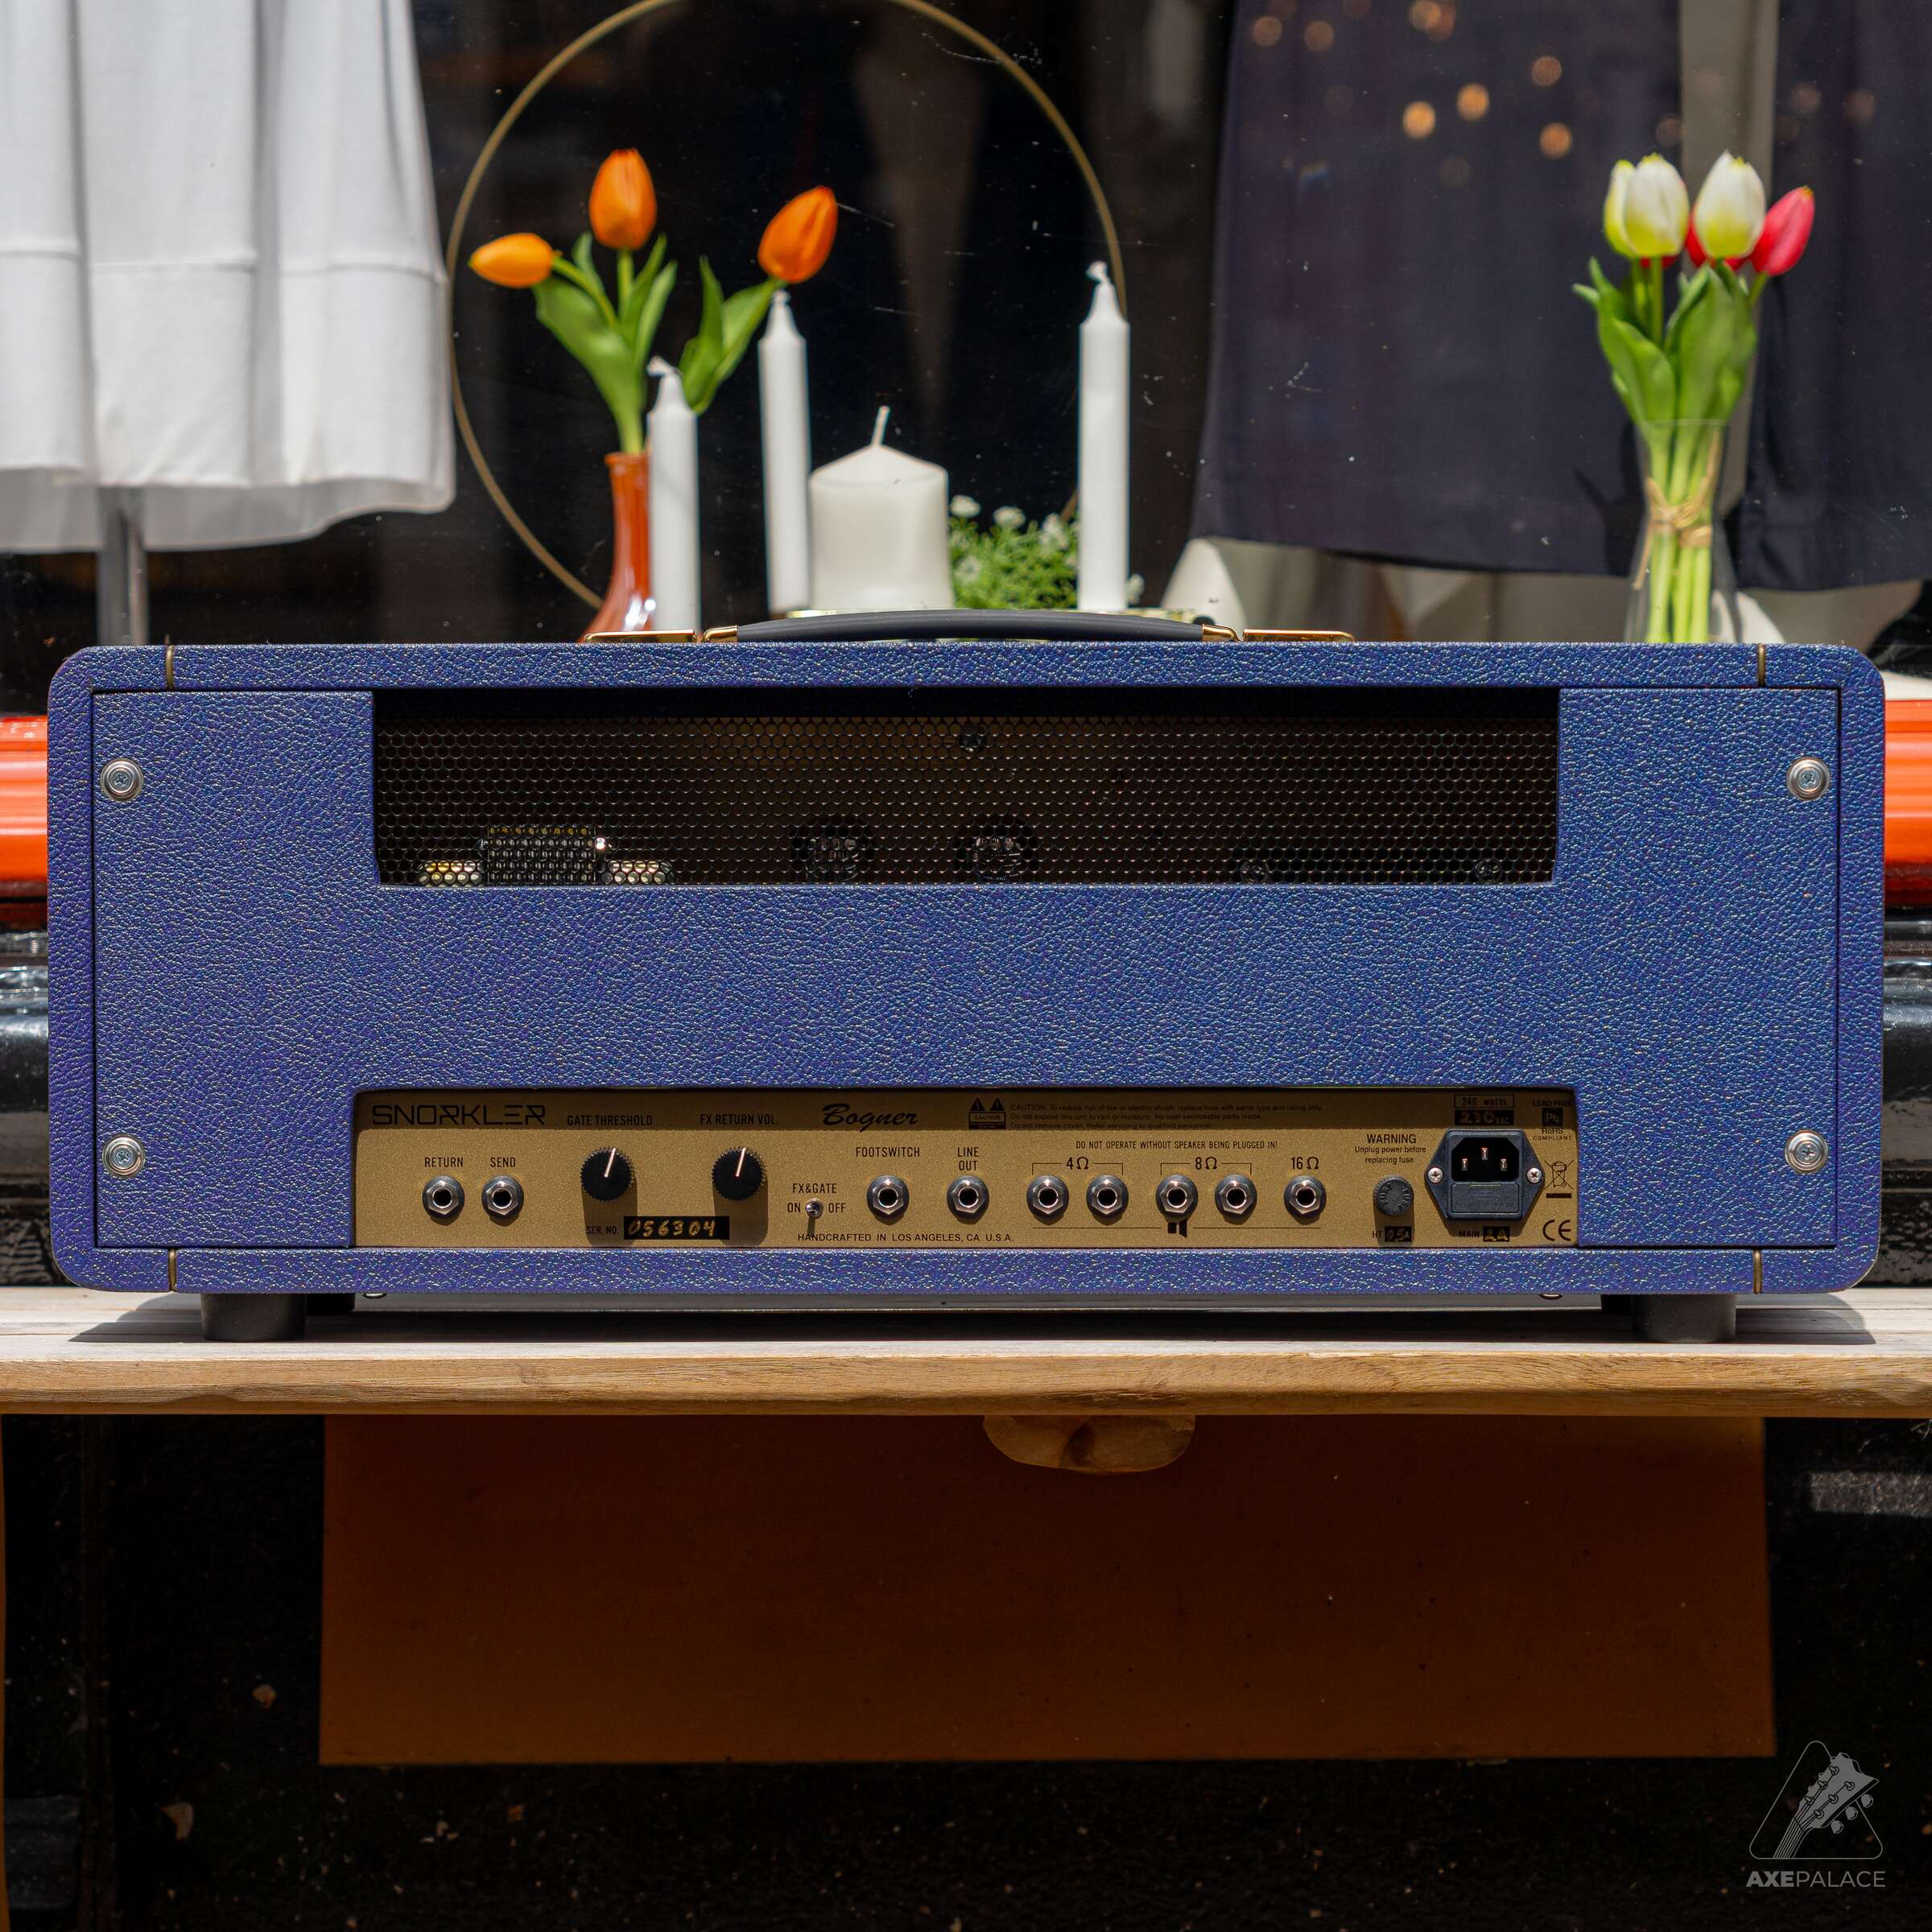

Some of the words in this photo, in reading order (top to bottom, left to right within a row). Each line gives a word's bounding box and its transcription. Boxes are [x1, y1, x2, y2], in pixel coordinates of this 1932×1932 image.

[1484, 1097, 1508, 1106] watts
[1533, 1100, 1552, 1108] LEAD
[372, 1104, 546, 1125] SNORKLER
[567, 1114, 592, 1126] GATE
[594, 1114, 653, 1126] THRESHOLD
[700, 1113, 712, 1125] FX
[715, 1113, 754, 1125] RETURN
[758, 1113, 779, 1125] VOL.
[822, 1103, 919, 1133] Bogner
[1366, 1133, 1417, 1144] WARNING
[1075, 1141, 1086, 1150] DO
[1088, 1141, 1103, 1150] NOT
[1106, 1141, 1137, 1150] OPERATE
[1140, 1141, 1171, 1150] WITHOUT
[1174, 1141, 1206, 1150] SPEAKER
[1209, 1141, 1230, 1150] BEING
[1232, 1141, 1265, 1150] PLUGGED
[1268, 1141, 1278, 1150] IN!
[1355, 1146, 1380, 1154] Unplug
[1381, 1146, 1402, 1154] power
[856, 1146, 920, 1158] FOOTSWITCH
[957, 1146, 980, 1158] LINE
[424, 1157, 464, 1168] RETURN
[489, 1157, 516, 1168] SEND
[958, 1160, 978, 1171] OUT
[1364, 1156, 1397, 1165] replacing
[792, 1183, 837, 1194] FX&GATE
[787, 1202, 801, 1213] ON
[828, 1202, 846, 1213] OFF
[586, 1225, 604, 1235] SER.
[605, 1225, 619, 1235] NO.
[628, 1219, 716, 1237] 056304
[1542, 1220, 1571, 1242] CE
[798, 1233, 872, 1242] HANDCRAFTED
[877, 1233, 886, 1242] IN
[892, 1233, 912, 1242] LOS
[914, 1233, 964, 1243] ANGELES,
[966, 1233, 980, 1242] CA
[985, 1233, 1014, 1242] U.S.A.
[1373, 1230, 1383, 1238] HT
[1459, 1230, 1480, 1239] MAIN
